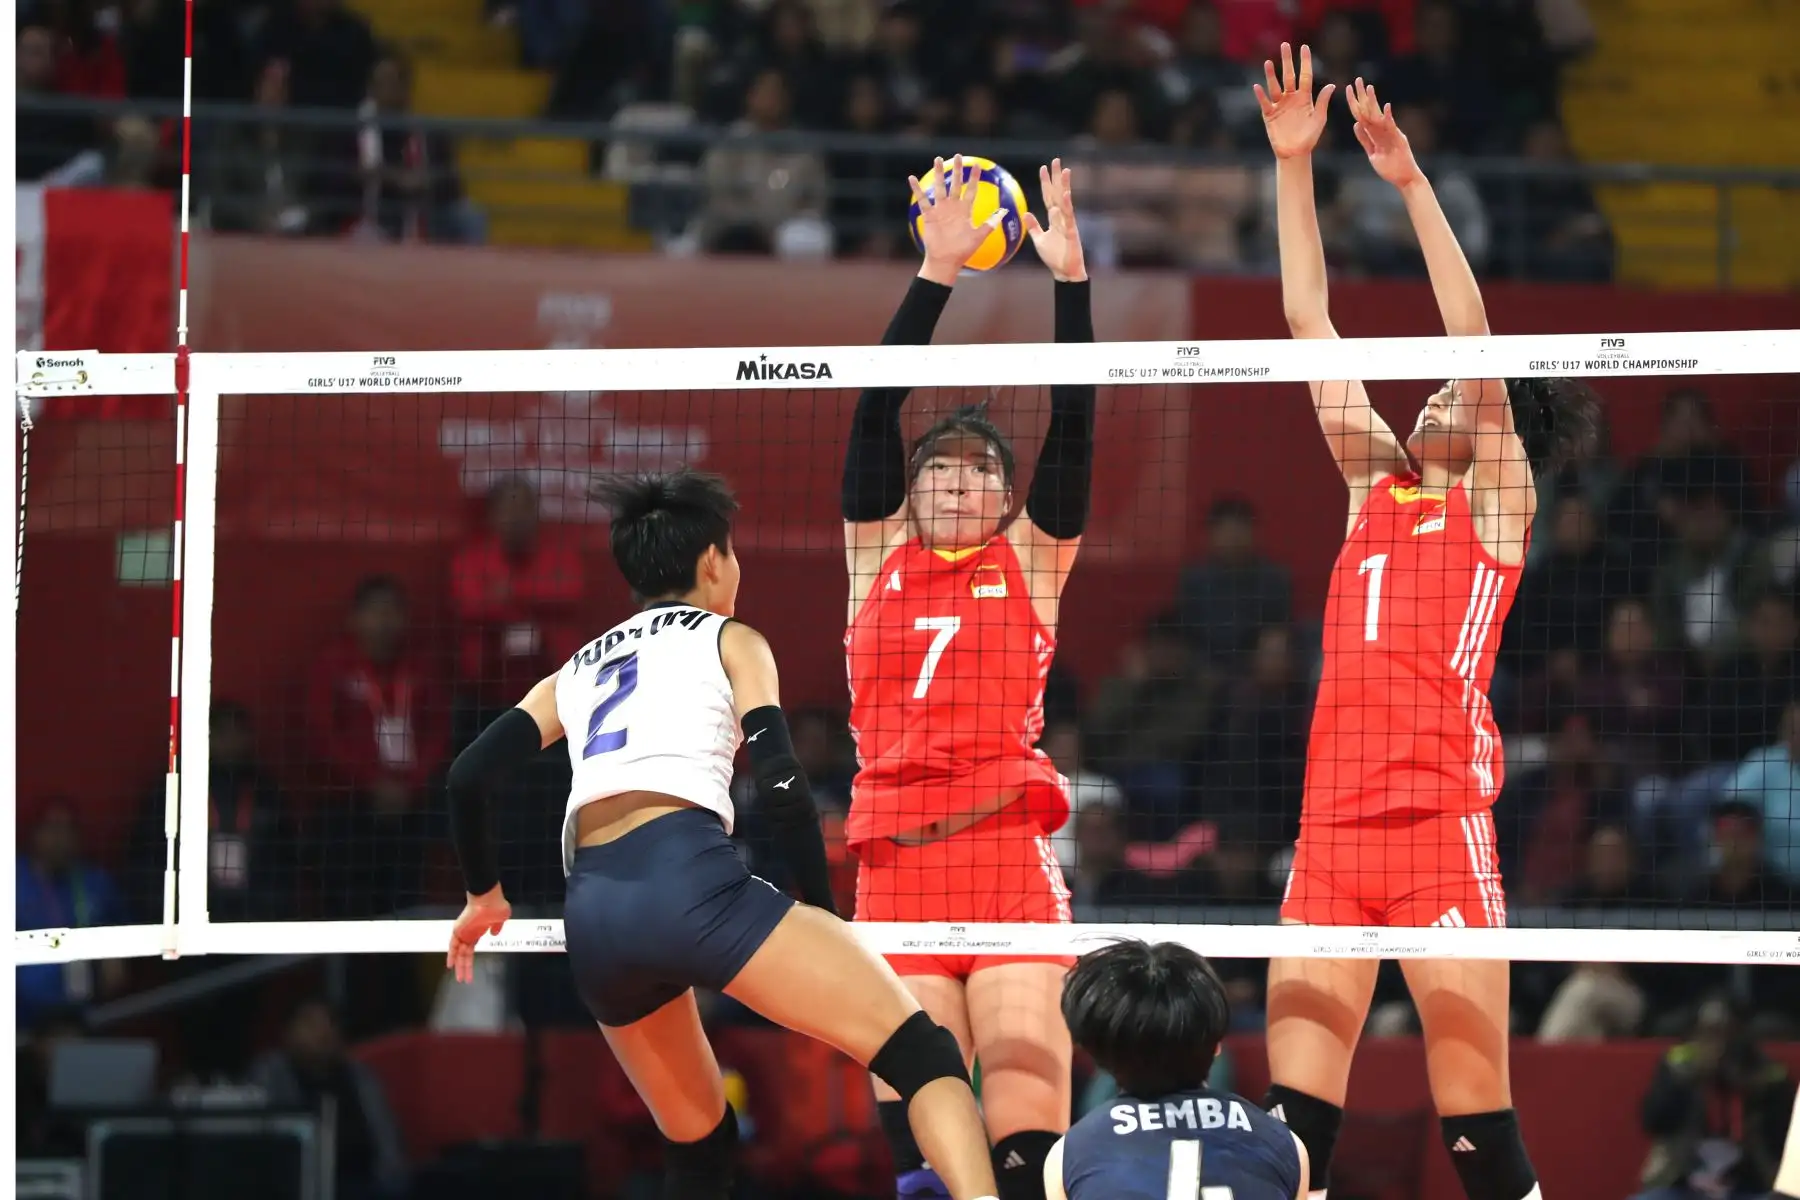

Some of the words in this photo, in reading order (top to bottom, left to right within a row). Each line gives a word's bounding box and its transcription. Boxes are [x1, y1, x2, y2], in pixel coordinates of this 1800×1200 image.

[1600, 339, 1625, 347] FIVB
[1177, 347, 1200, 356] FIVB
[46, 358, 84, 368] Senoh
[373, 356, 396, 365] FIVB
[1529, 360, 1560, 370] GIRLS'
[1562, 361, 1580, 370] U17
[1585, 360, 1619, 370] WORLD
[1622, 359, 1698, 369] CHAMPIONSHIP
[1108, 368, 1138, 378] GIRLS'
[1140, 369, 1157, 377] U17
[1162, 368, 1194, 377] WORLD
[1197, 367, 1270, 377] CHAMPIONSHIP
[308, 377, 336, 387] GIRLS'
[338, 378, 355, 387] U17
[359, 377, 391, 387] WORLD
[393, 376, 463, 387] CHAMPIONSHIP
[1358, 553, 1388, 641] 1
[912, 616, 961, 699] 7
[583, 650, 639, 760] 2
[1110, 1098, 1252, 1135] SEMBA
